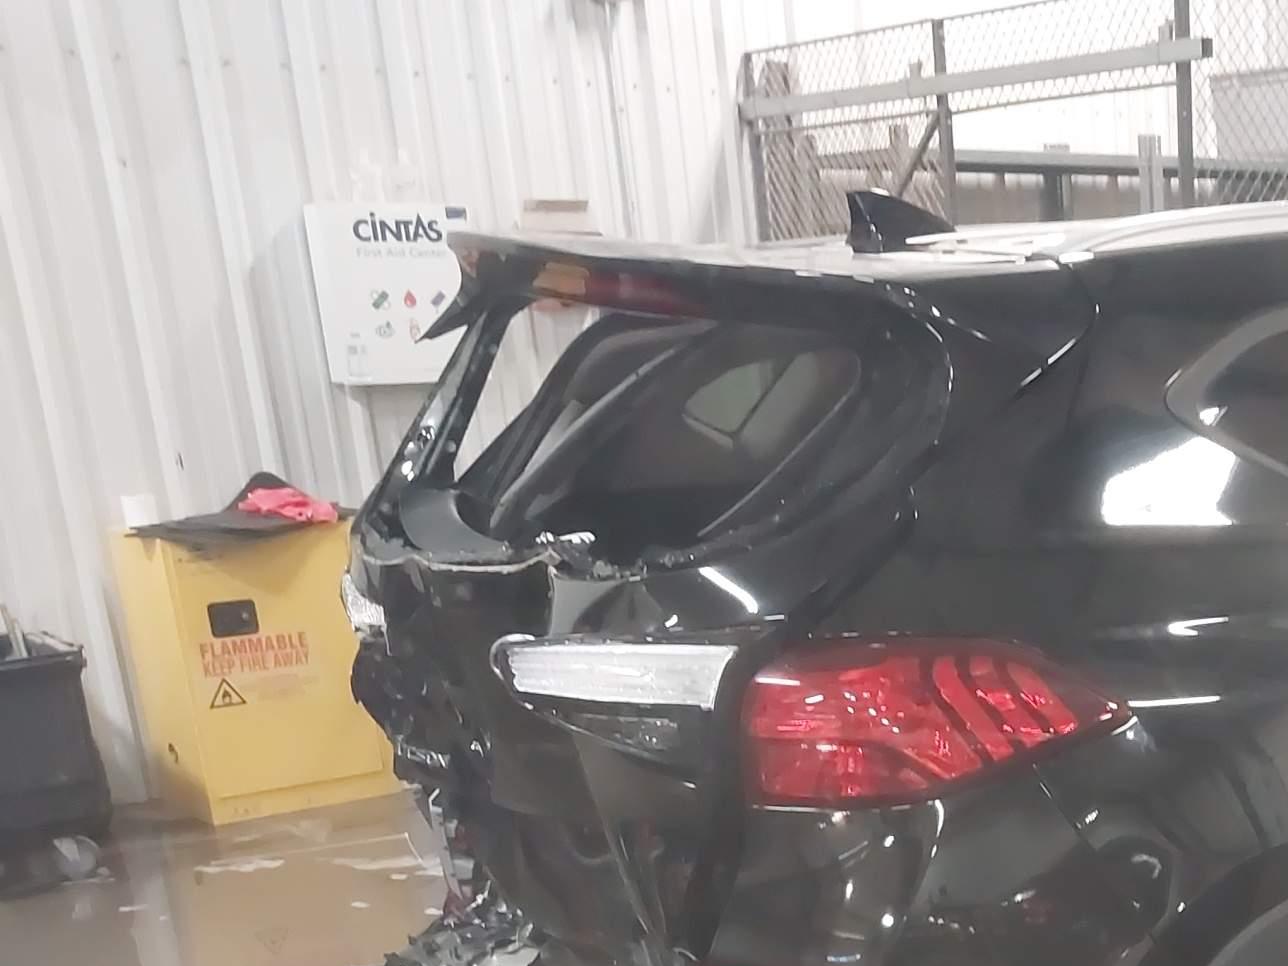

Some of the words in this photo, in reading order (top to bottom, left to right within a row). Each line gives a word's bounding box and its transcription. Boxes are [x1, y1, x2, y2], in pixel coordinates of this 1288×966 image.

[355, 247, 382, 258] First
[387, 247, 405, 257] Aid
[199, 631, 306, 660] FLAMMABLE
[202, 654, 235, 678] KEEP
[239, 651, 269, 673] FIRE
[273, 648, 309, 668] AWAY
